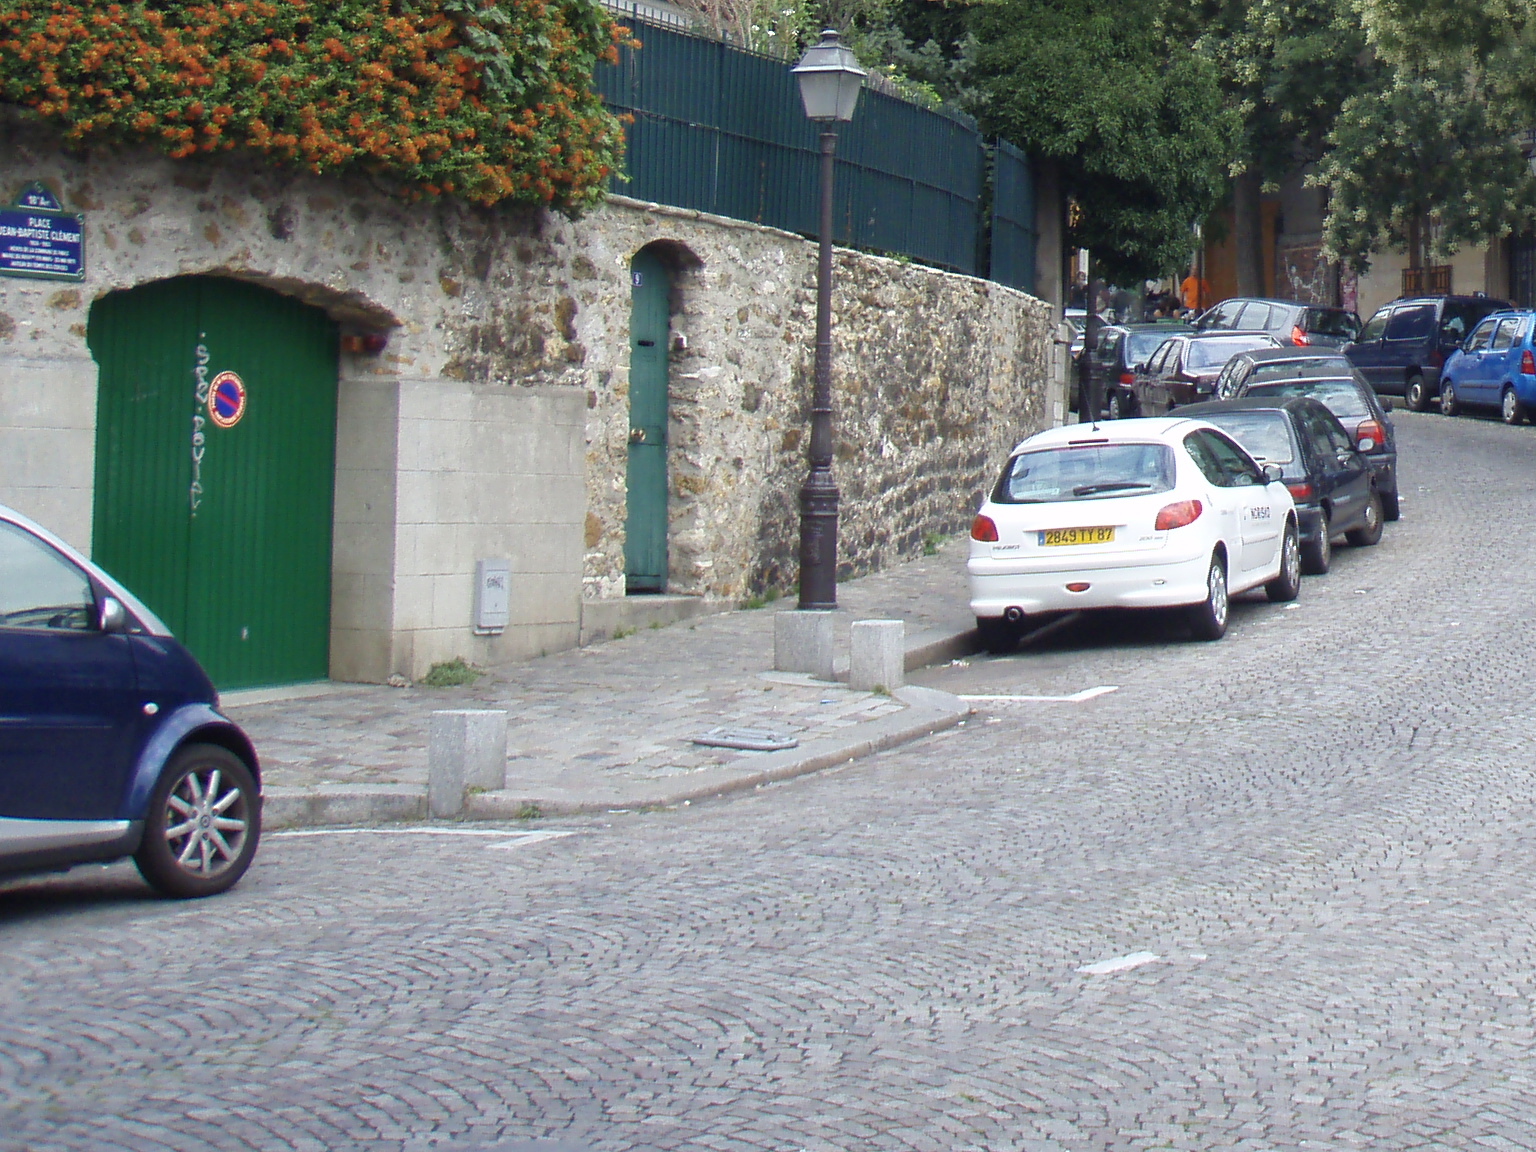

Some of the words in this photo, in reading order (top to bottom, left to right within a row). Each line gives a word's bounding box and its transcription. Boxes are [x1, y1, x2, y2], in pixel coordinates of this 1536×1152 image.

[29, 217, 51, 229] PLACE
[1045, 529, 1077, 544] 2849
[1078, 528, 1094, 542] TY
[1097, 527, 1113, 541] 87
